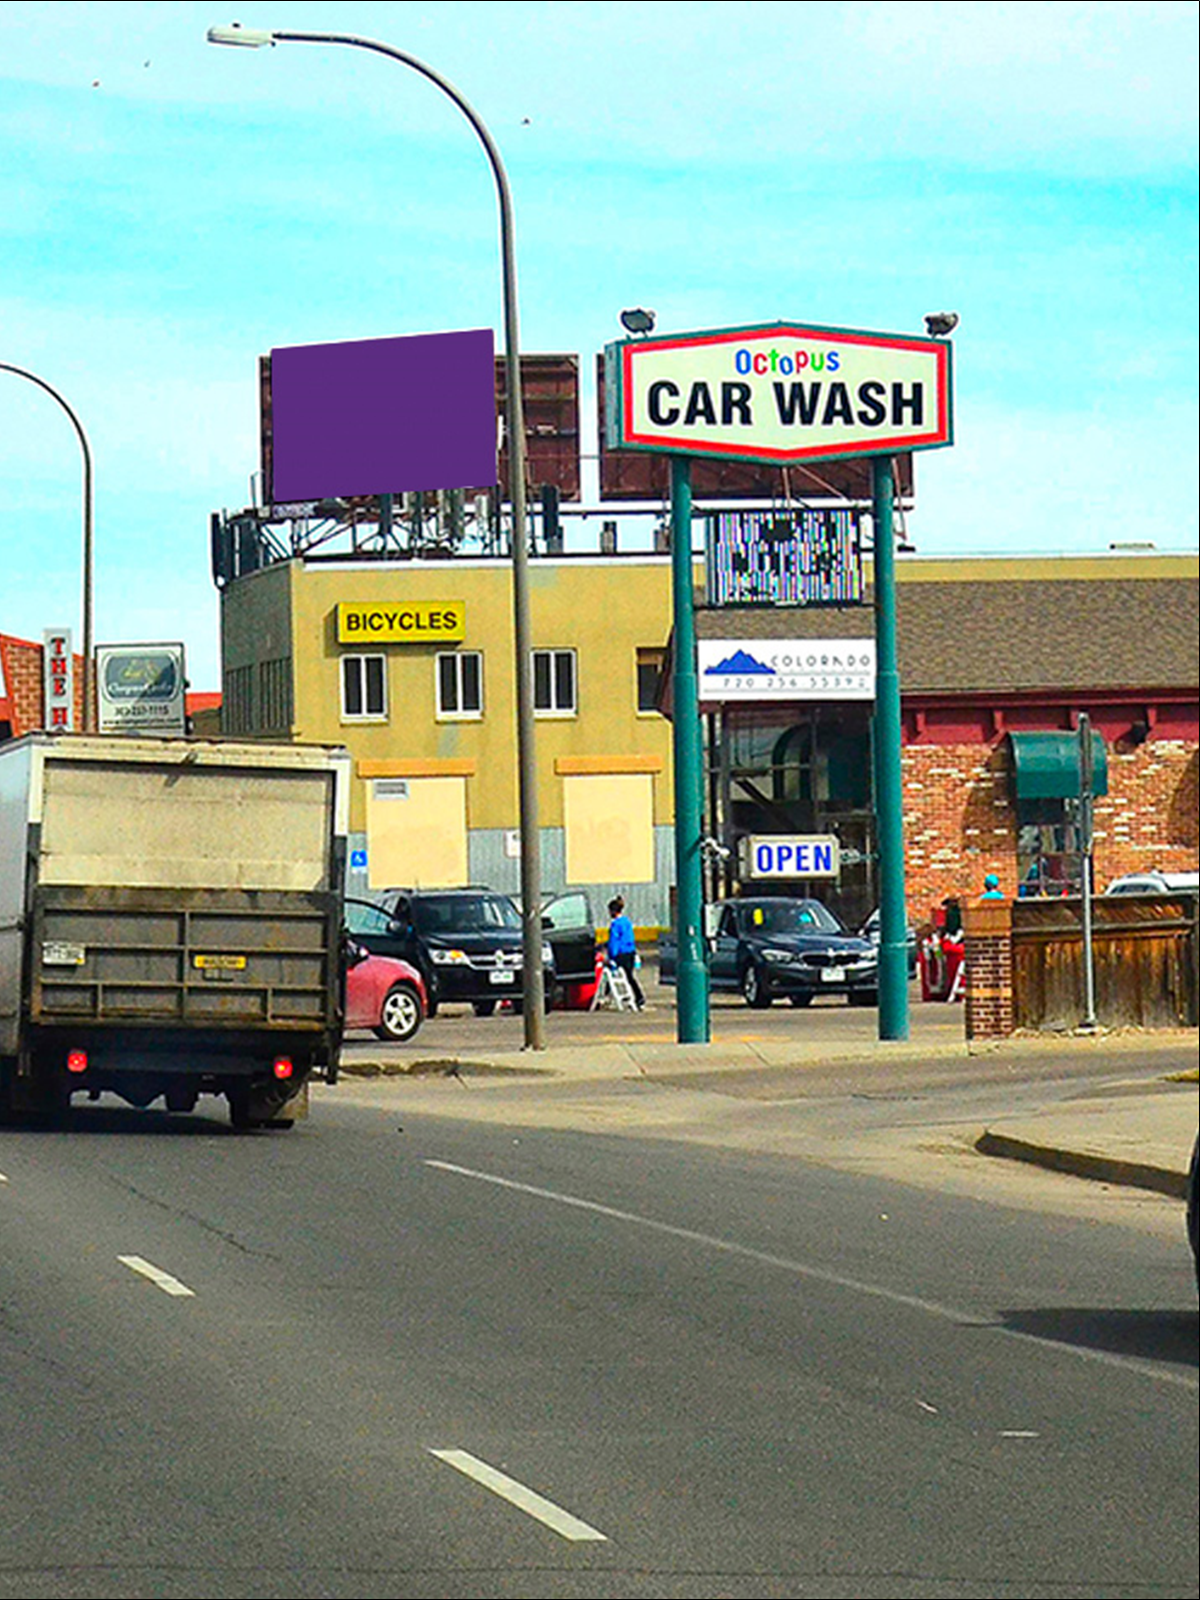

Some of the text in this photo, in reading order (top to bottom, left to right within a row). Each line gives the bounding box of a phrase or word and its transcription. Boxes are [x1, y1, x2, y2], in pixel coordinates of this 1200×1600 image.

[735, 349, 840, 375] Octopus
[647, 380, 924, 426] CAR WASH
[346, 612, 458, 631] BICYCLES
[50, 637, 67, 695] THE
[770, 655, 871, 667] COLORADO
[724, 677, 755, 688] 720
[757, 844, 832, 873] OPEN
